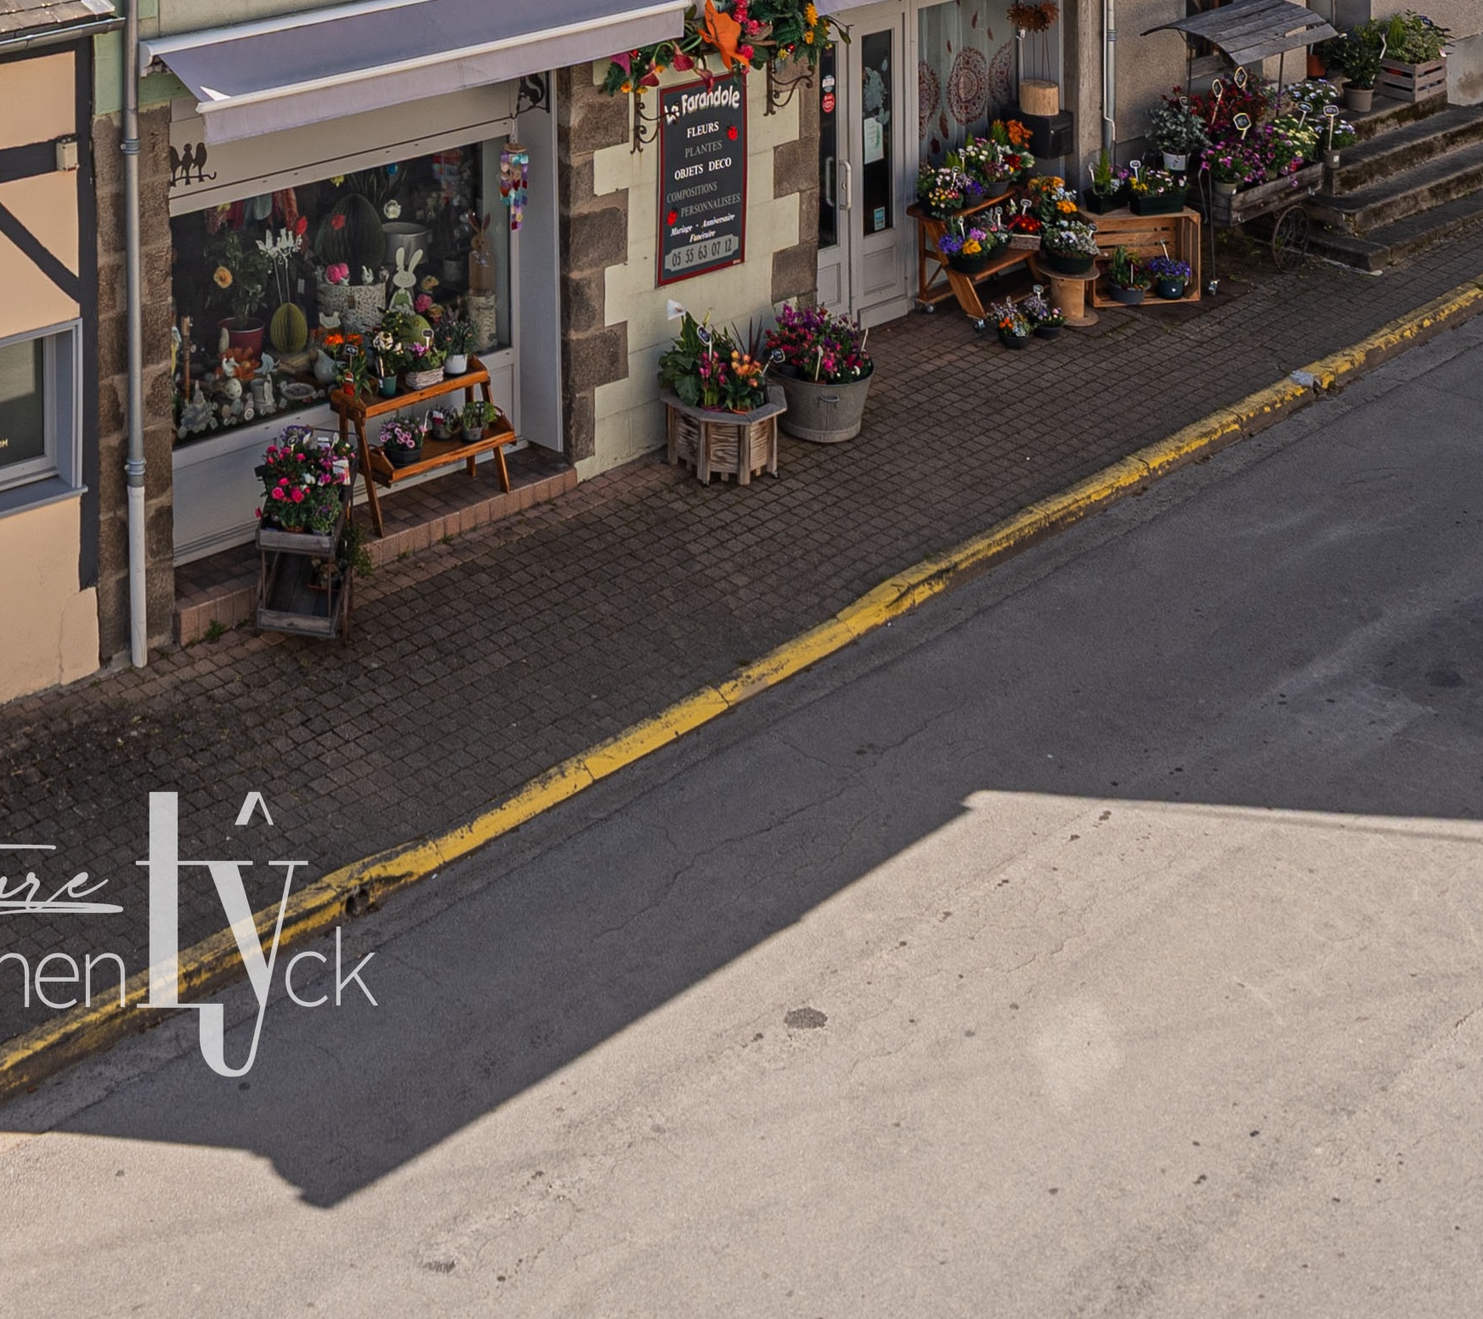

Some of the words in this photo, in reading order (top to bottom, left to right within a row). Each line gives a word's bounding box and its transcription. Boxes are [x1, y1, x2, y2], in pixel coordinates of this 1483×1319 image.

[681, 85, 740, 116] Farandole
[686, 121, 720, 138] FLEURS
[685, 140, 723, 158] PLANTES
[674, 164, 704, 181] OBJETS
[708, 157, 732, 172] DECO
[666, 181, 718, 204] COMPOSITIONS
[680, 193, 741, 218] PERSONNALISEES
[671, 252, 681, 267] 05
[685, 249, 694, 264] 55
[698, 245, 707, 260] 63
[711, 241, 721, 256] 07
[724, 238, 732, 253] 12
